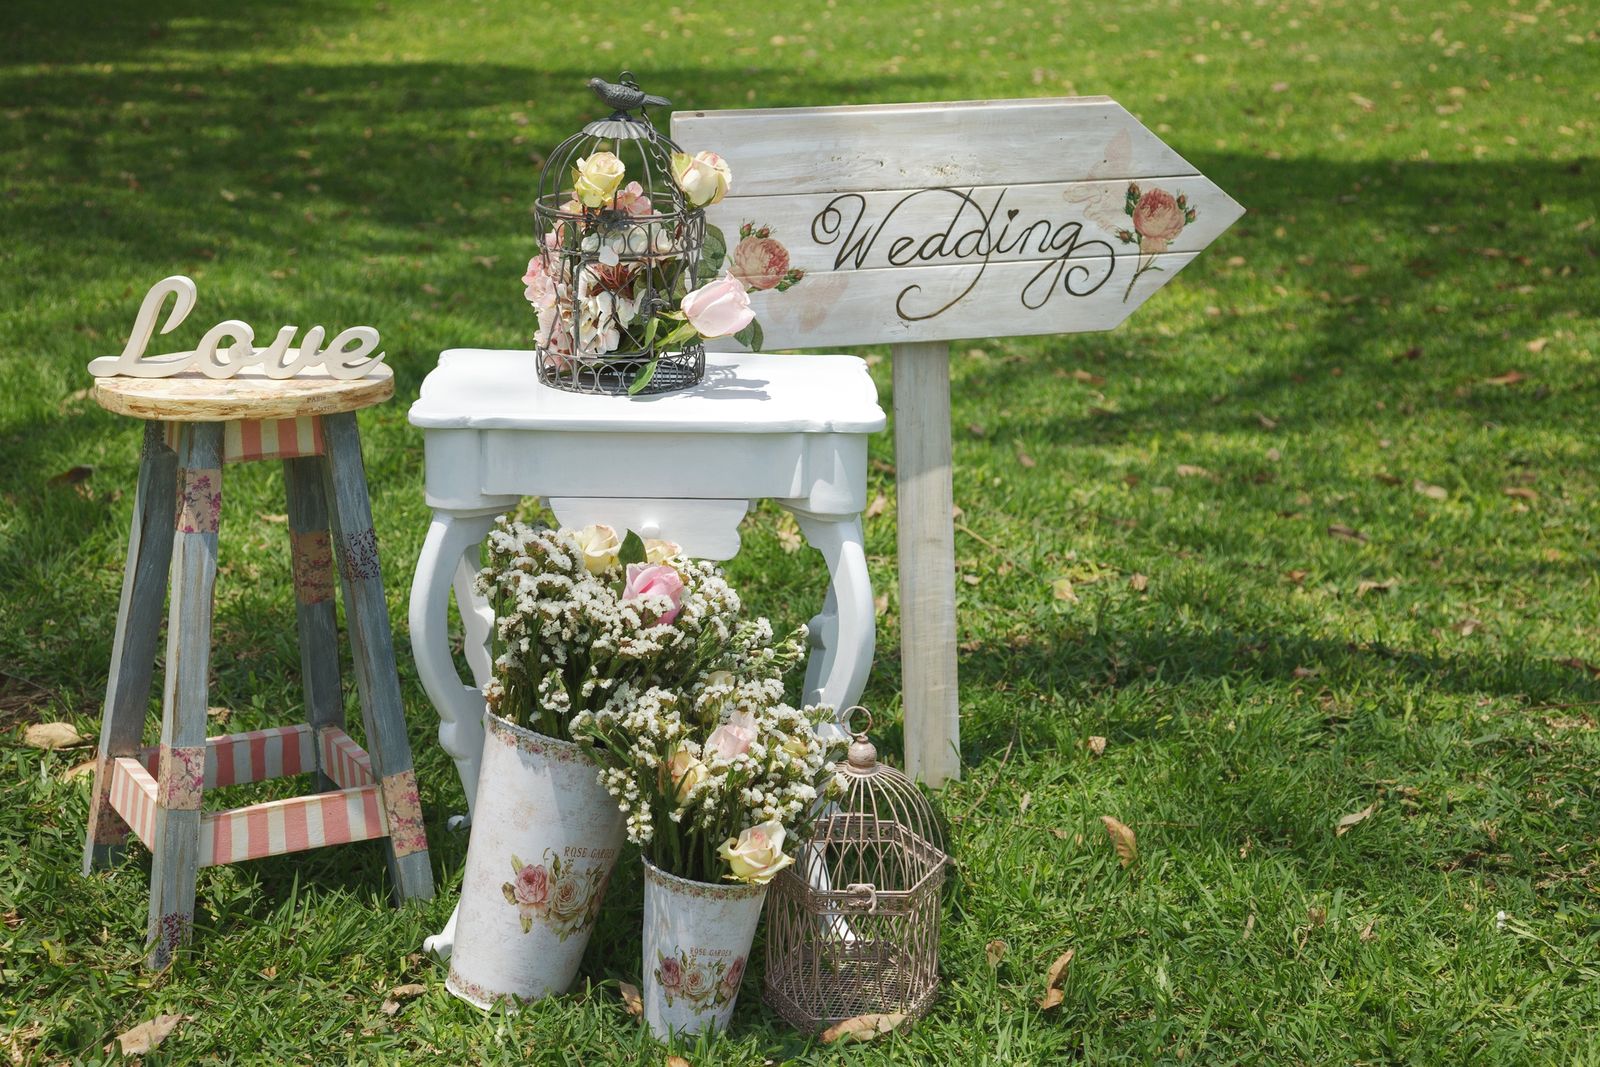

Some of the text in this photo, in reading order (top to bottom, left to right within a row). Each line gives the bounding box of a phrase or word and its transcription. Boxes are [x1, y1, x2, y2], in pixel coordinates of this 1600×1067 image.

[811, 187, 1116, 321] Wedding
[87, 275, 386, 380] Love
[564, 846, 588, 858] ROSE
[689, 947, 707, 956] ROSE
